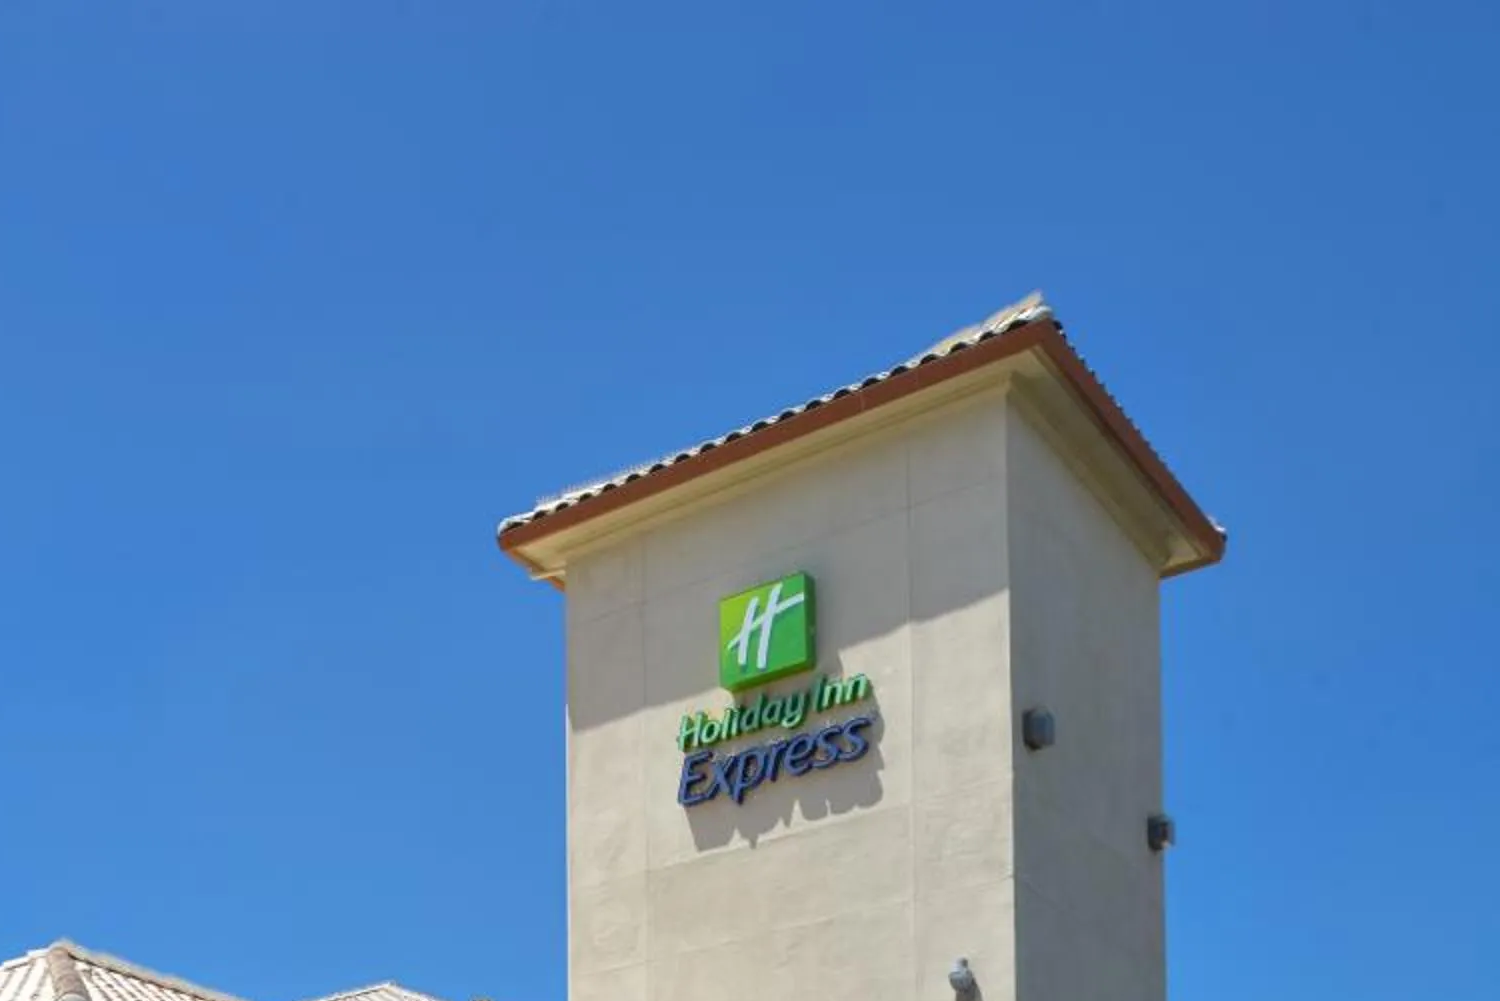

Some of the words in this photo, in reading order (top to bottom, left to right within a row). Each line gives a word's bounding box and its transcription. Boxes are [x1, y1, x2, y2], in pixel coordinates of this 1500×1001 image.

[727, 582, 805, 670] H
[677, 692, 809, 752] Holiday
[810, 673, 873, 713] Inn
[677, 716, 873, 808] Express
